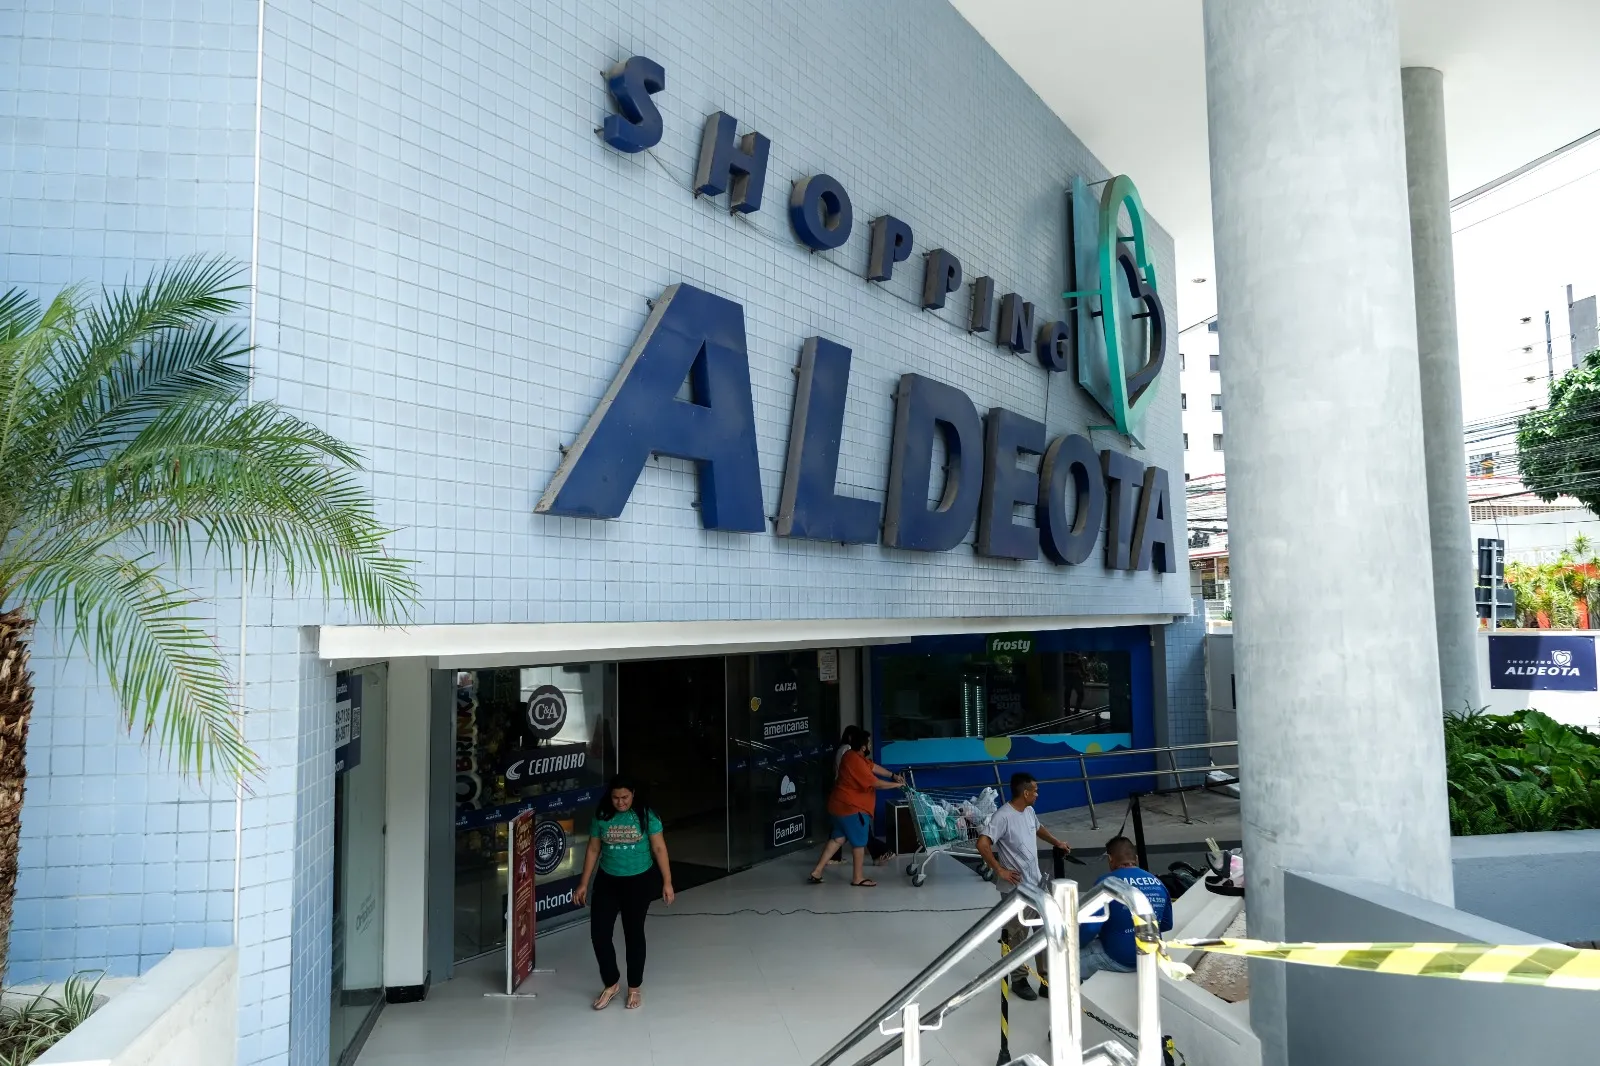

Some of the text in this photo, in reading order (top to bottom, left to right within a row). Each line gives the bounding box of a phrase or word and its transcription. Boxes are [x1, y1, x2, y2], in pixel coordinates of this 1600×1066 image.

[603, 56, 1070, 372] SHOPPING
[535, 282, 1176, 573] ALDEOTA
[992, 638, 1031, 653] frosty
[1504, 666, 1580, 676] ALDEOTA
[774, 682, 797, 692] CAIXA
[534, 702, 559, 720] C&A
[764, 720, 809, 736] americanas
[528, 752, 586, 776] CENTAURO
[775, 823, 803, 840] BanBan
